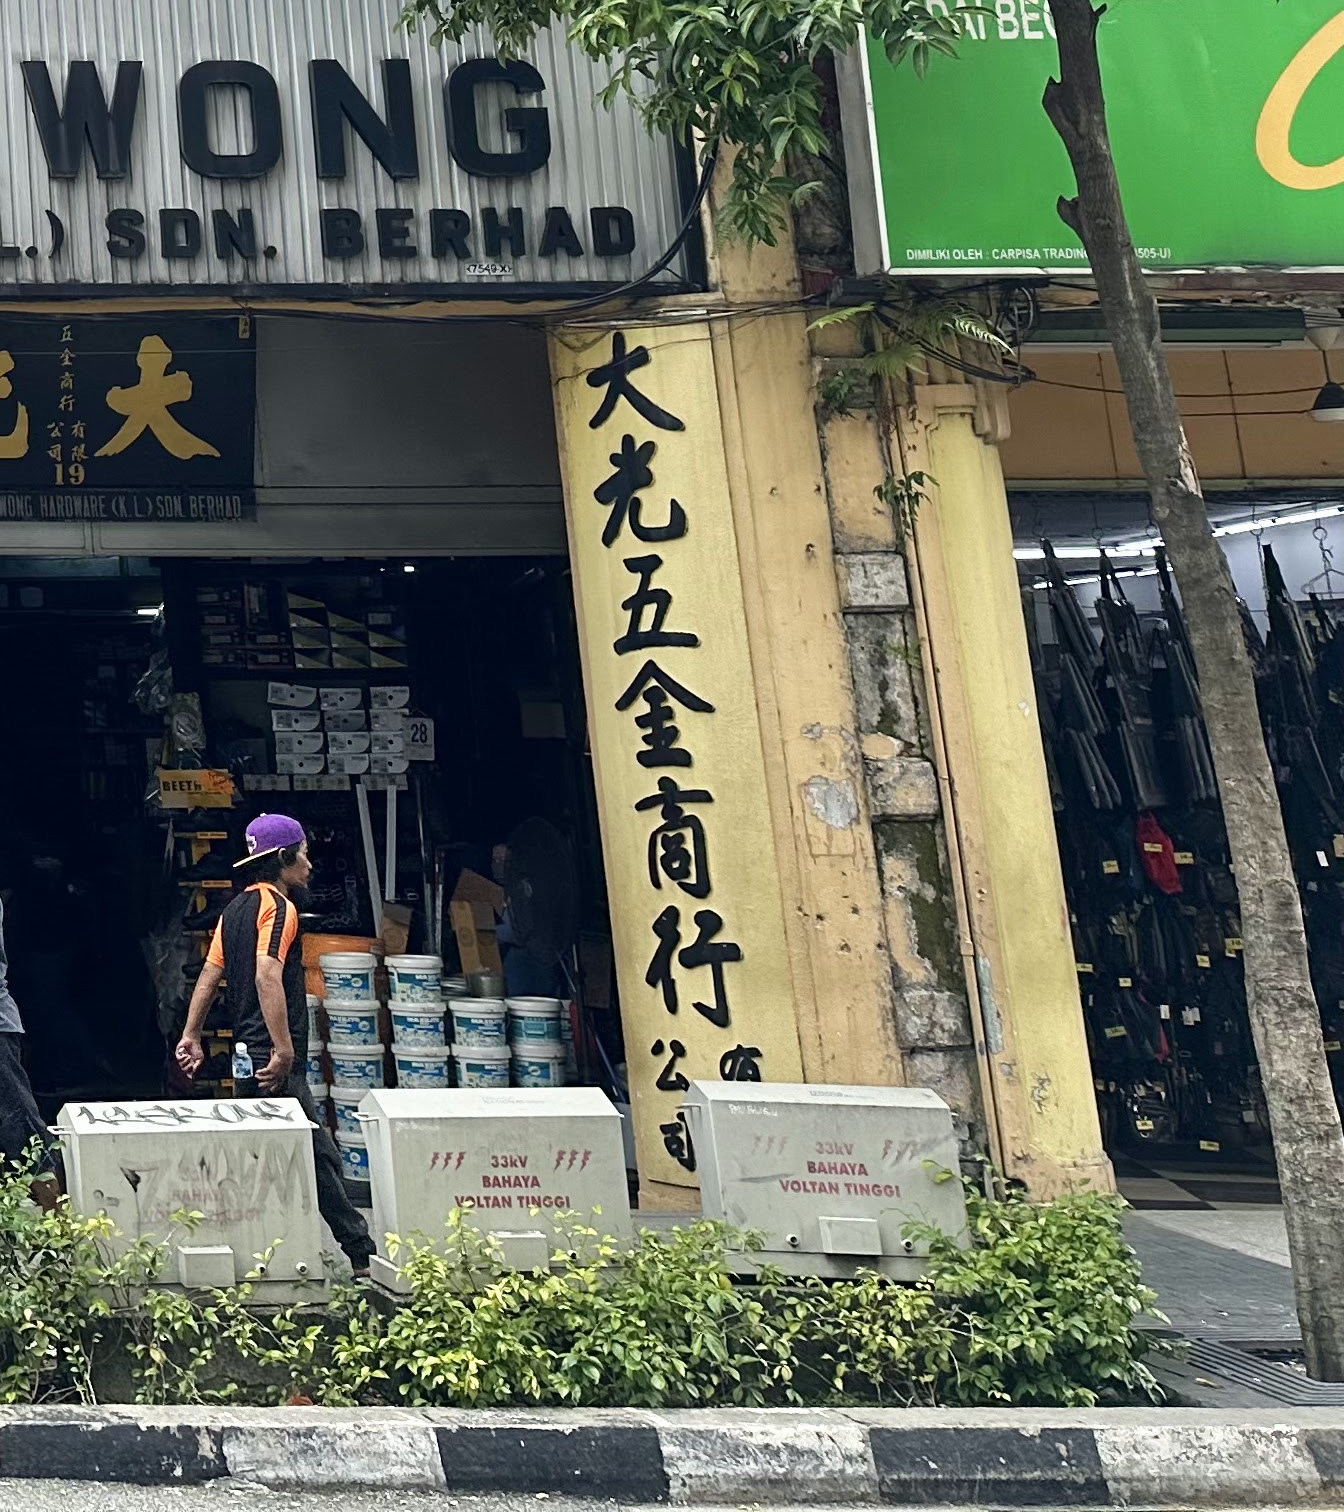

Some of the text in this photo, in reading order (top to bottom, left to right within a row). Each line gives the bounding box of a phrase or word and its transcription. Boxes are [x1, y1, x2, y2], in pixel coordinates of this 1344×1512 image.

[106, 207, 278, 260] SDN.
[320, 206, 637, 259] BERHAD
[907, 249, 950, 260] DIMILIKI
[992, 248, 1041, 260] CARPISA
[54, 462, 85, 485] 19
[39, 495, 108, 518] HARDWARE
[189, 495, 242, 520] BERHAD
[410, 723, 428, 743] 28
[815, 1141, 854, 1155] 33kV
[490, 1155, 528, 1168] 33kV
[806, 1161, 869, 1176] BAHAYA
[482, 1175, 541, 1188] BAHAYA
[779, 1179, 901, 1198] VOLTAN TINGGI
[454, 1195, 571, 1209] VOLTAN TINGGI
